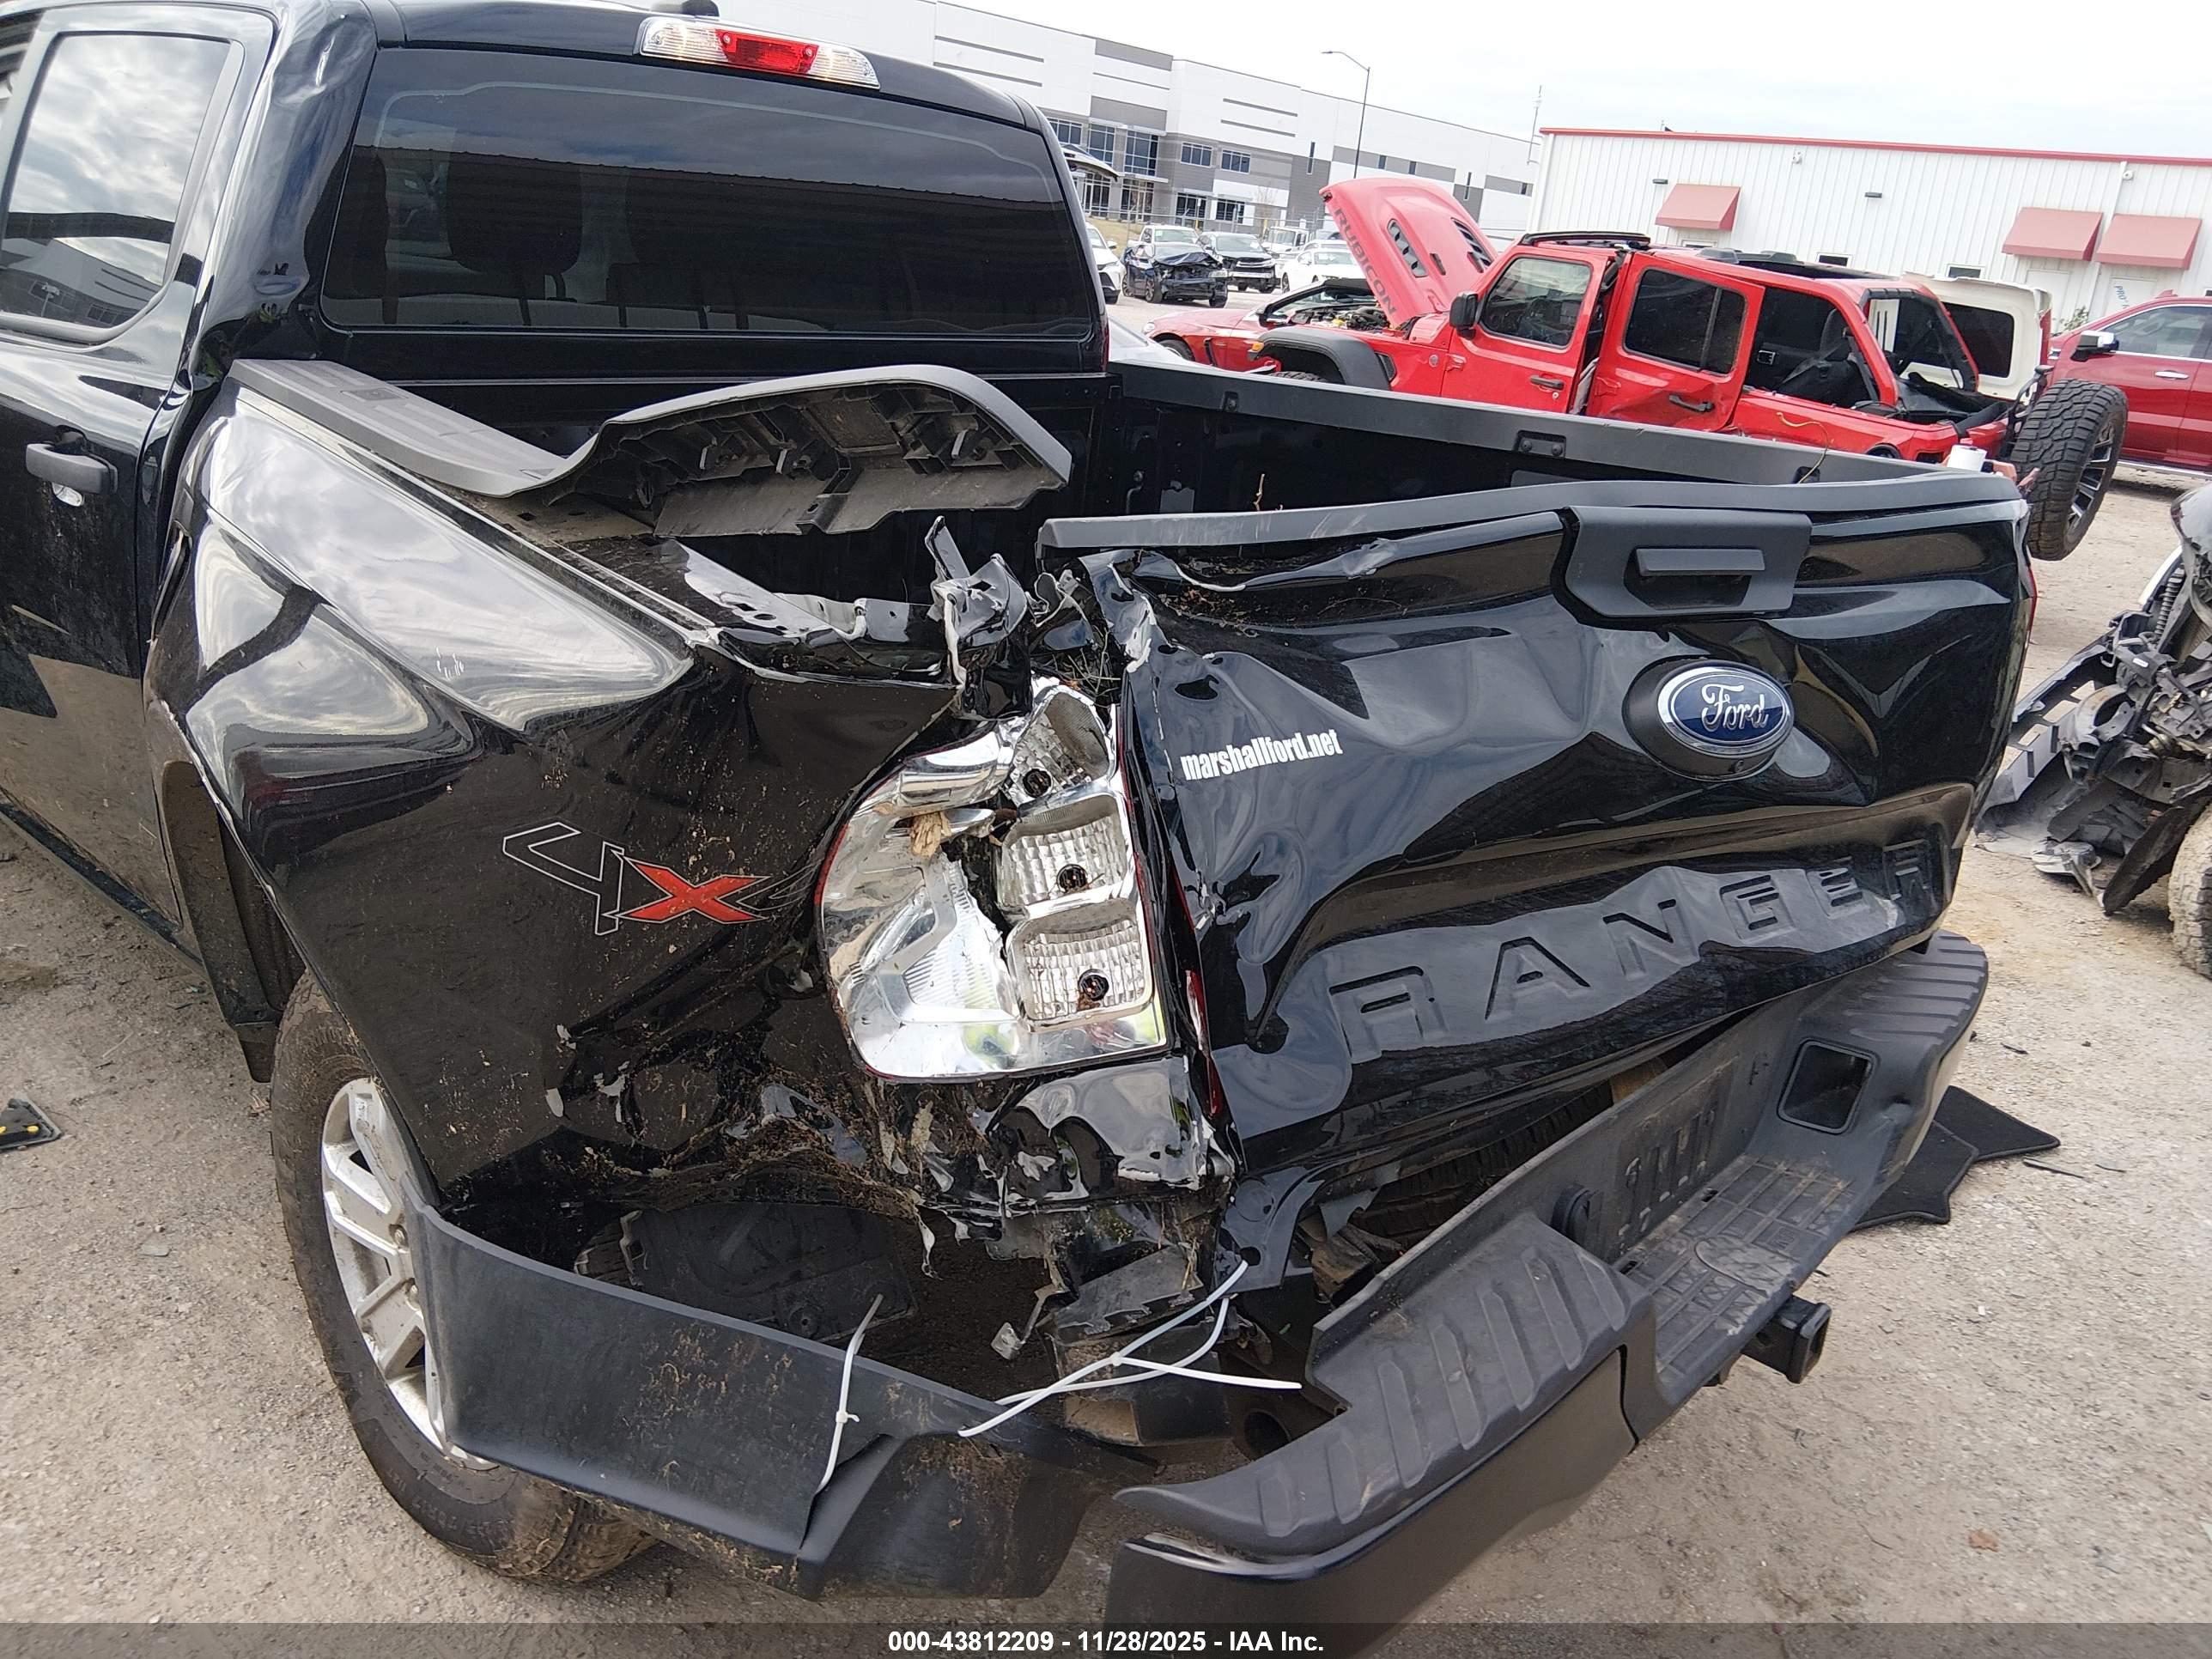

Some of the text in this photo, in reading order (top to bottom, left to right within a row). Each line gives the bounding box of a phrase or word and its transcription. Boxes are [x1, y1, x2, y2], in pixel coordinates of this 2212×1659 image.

[1334, 208, 1397, 315] RUBICON
[1701, 684, 1769, 732] Ford
[1181, 729, 1343, 781] marshallford.net
[1328, 838, 1940, 1064] RANGER
